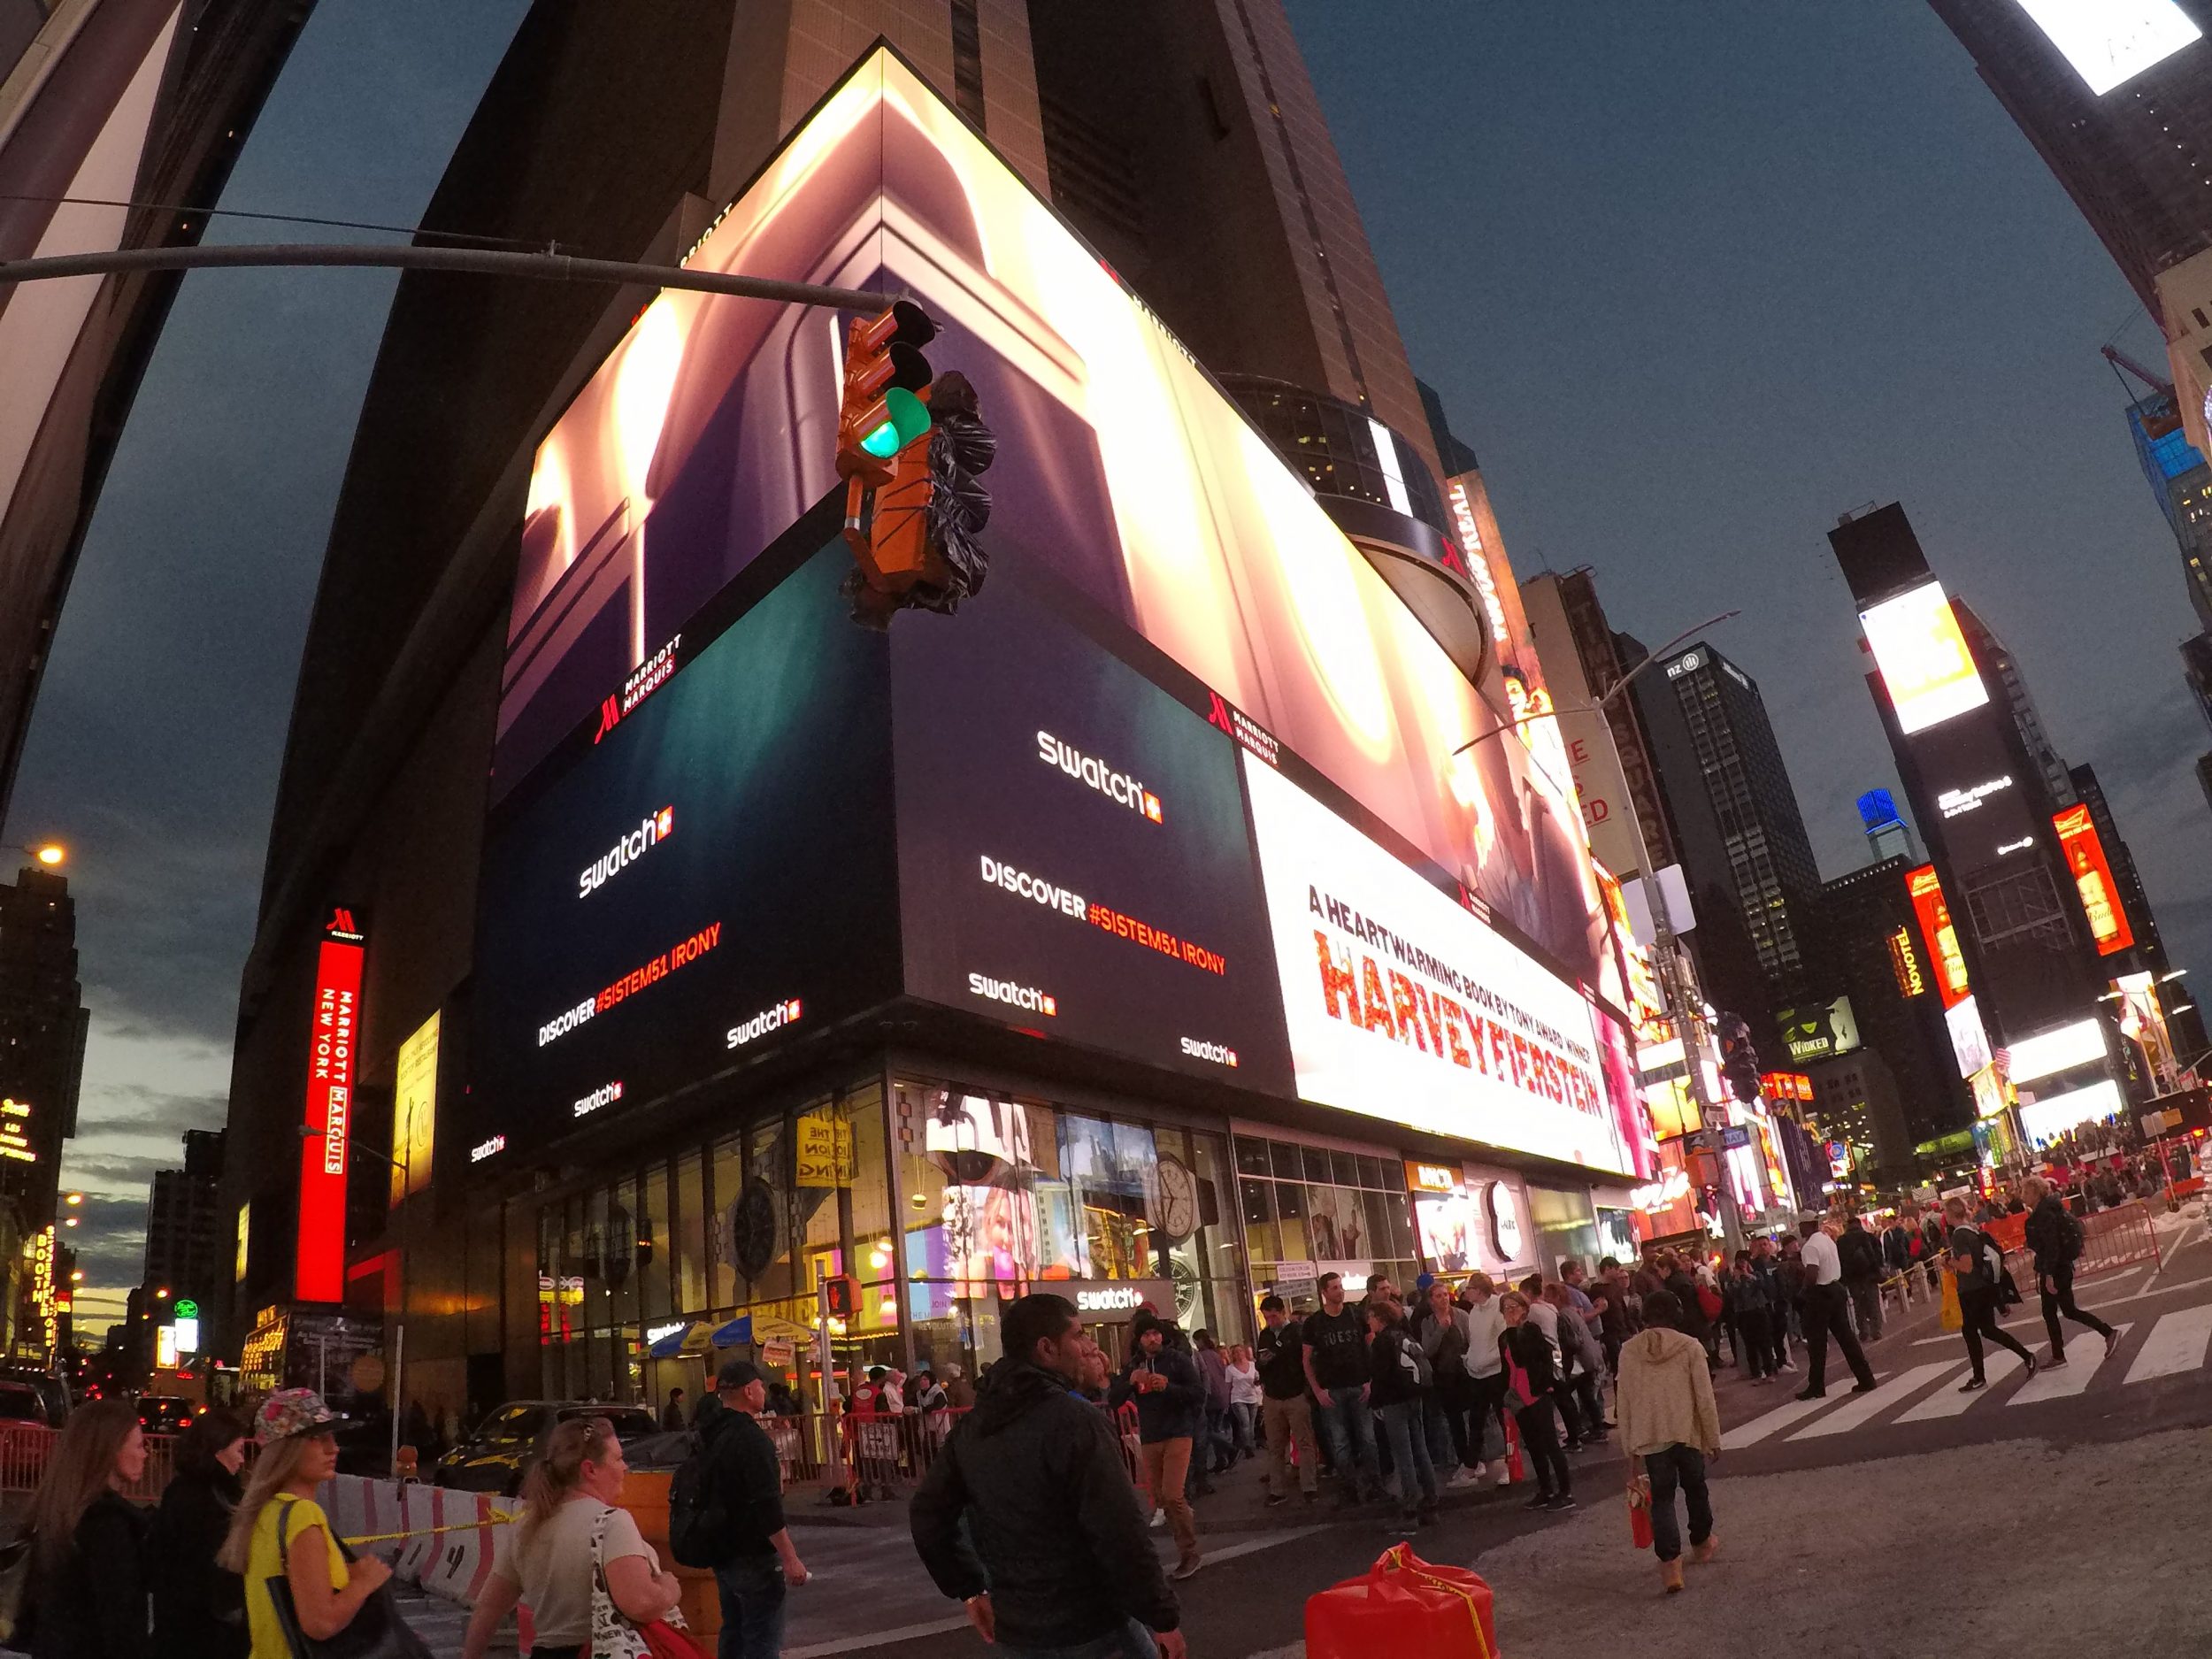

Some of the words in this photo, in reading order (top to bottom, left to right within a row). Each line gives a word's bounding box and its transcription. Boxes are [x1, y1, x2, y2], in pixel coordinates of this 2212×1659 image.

[623, 658, 673, 713] MARQUIS
[625, 634, 681, 695] MARRIOTT
[1233, 710, 1279, 753] MARRIOTT
[1235, 726, 1278, 764] MARQUIS
[1037, 731, 1145, 815] swatch
[580, 809, 658, 899] swatch
[981, 855, 1087, 920] DISCOVER
[1089, 902, 1180, 959] #SISTEM51
[1181, 941, 1226, 976] IRONY
[538, 997, 595, 1048] DISCOVER
[595, 955, 669, 1014] #SISTEM51
[671, 921, 721, 971] IRONY
[1309, 884, 1325, 918] A
[1462, 975, 1495, 1013] BOOK
[1494, 994, 1509, 1019] BY
[1508, 1002, 1534, 1034] TONY
[1535, 1018, 1563, 1050] AWARD
[1895, 926, 1924, 995] NOVOTEL
[320, 988, 335, 1026] NEW
[969, 973, 1045, 1013] swatch
[334, 990, 353, 1083] MARRIOTT
[727, 1001, 789, 1048] swatch
[1181, 1036, 1231, 1065] swatch
[1313, 929, 1488, 1076] HARVEY
[1486, 1018, 1603, 1119] FIERSTEIN
[316, 1033, 332, 1079] YORK
[327, 1087, 345, 1172] MARQUIS
[574, 1083, 614, 1118] swatch
[472, 1137, 499, 1163] swatch
[33, 1233, 47, 1302] BOOTH
[1077, 1286, 1134, 1310] swatch
